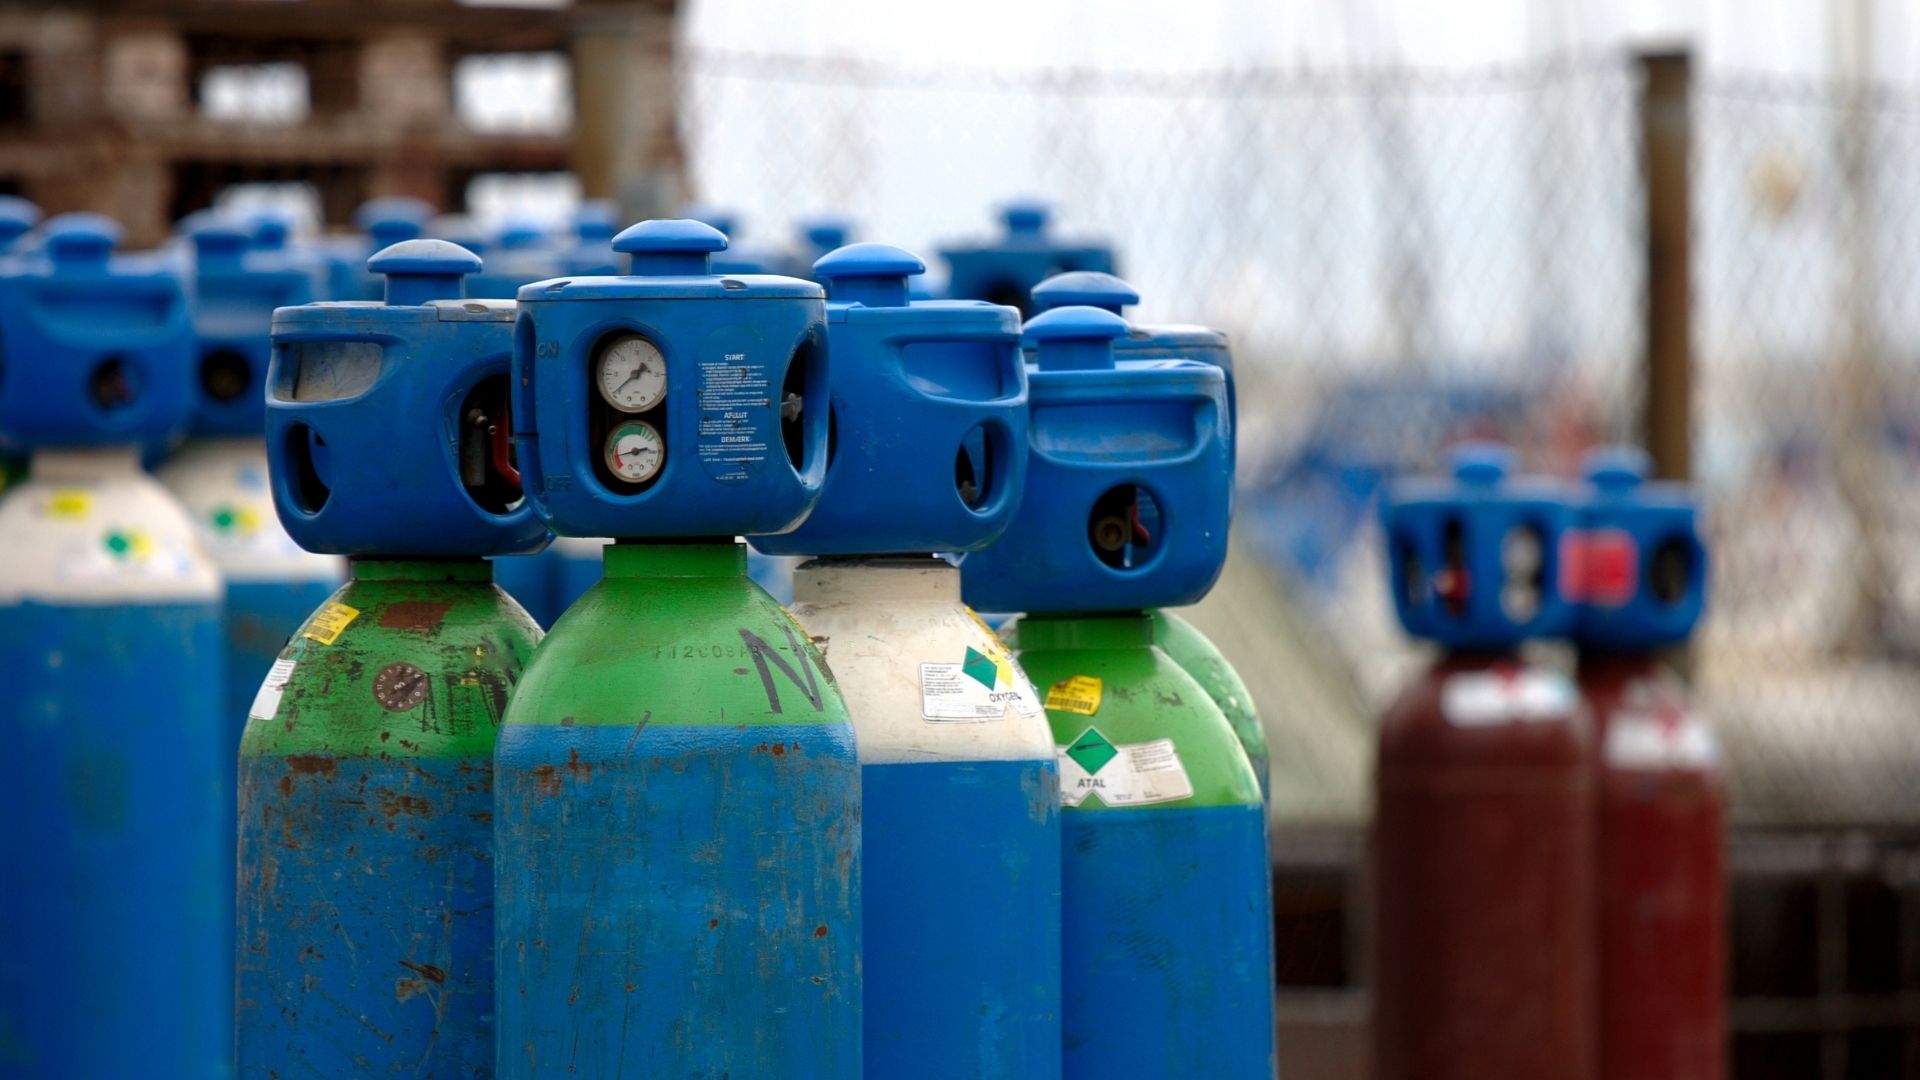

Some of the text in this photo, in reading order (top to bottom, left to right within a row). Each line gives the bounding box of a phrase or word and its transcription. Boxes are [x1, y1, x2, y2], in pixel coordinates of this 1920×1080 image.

[536, 341, 560, 358] ON
[738, 623, 824, 714] N
[987, 691, 1022, 703] OXYGEN
[1077, 778, 1106, 789] ATAL
